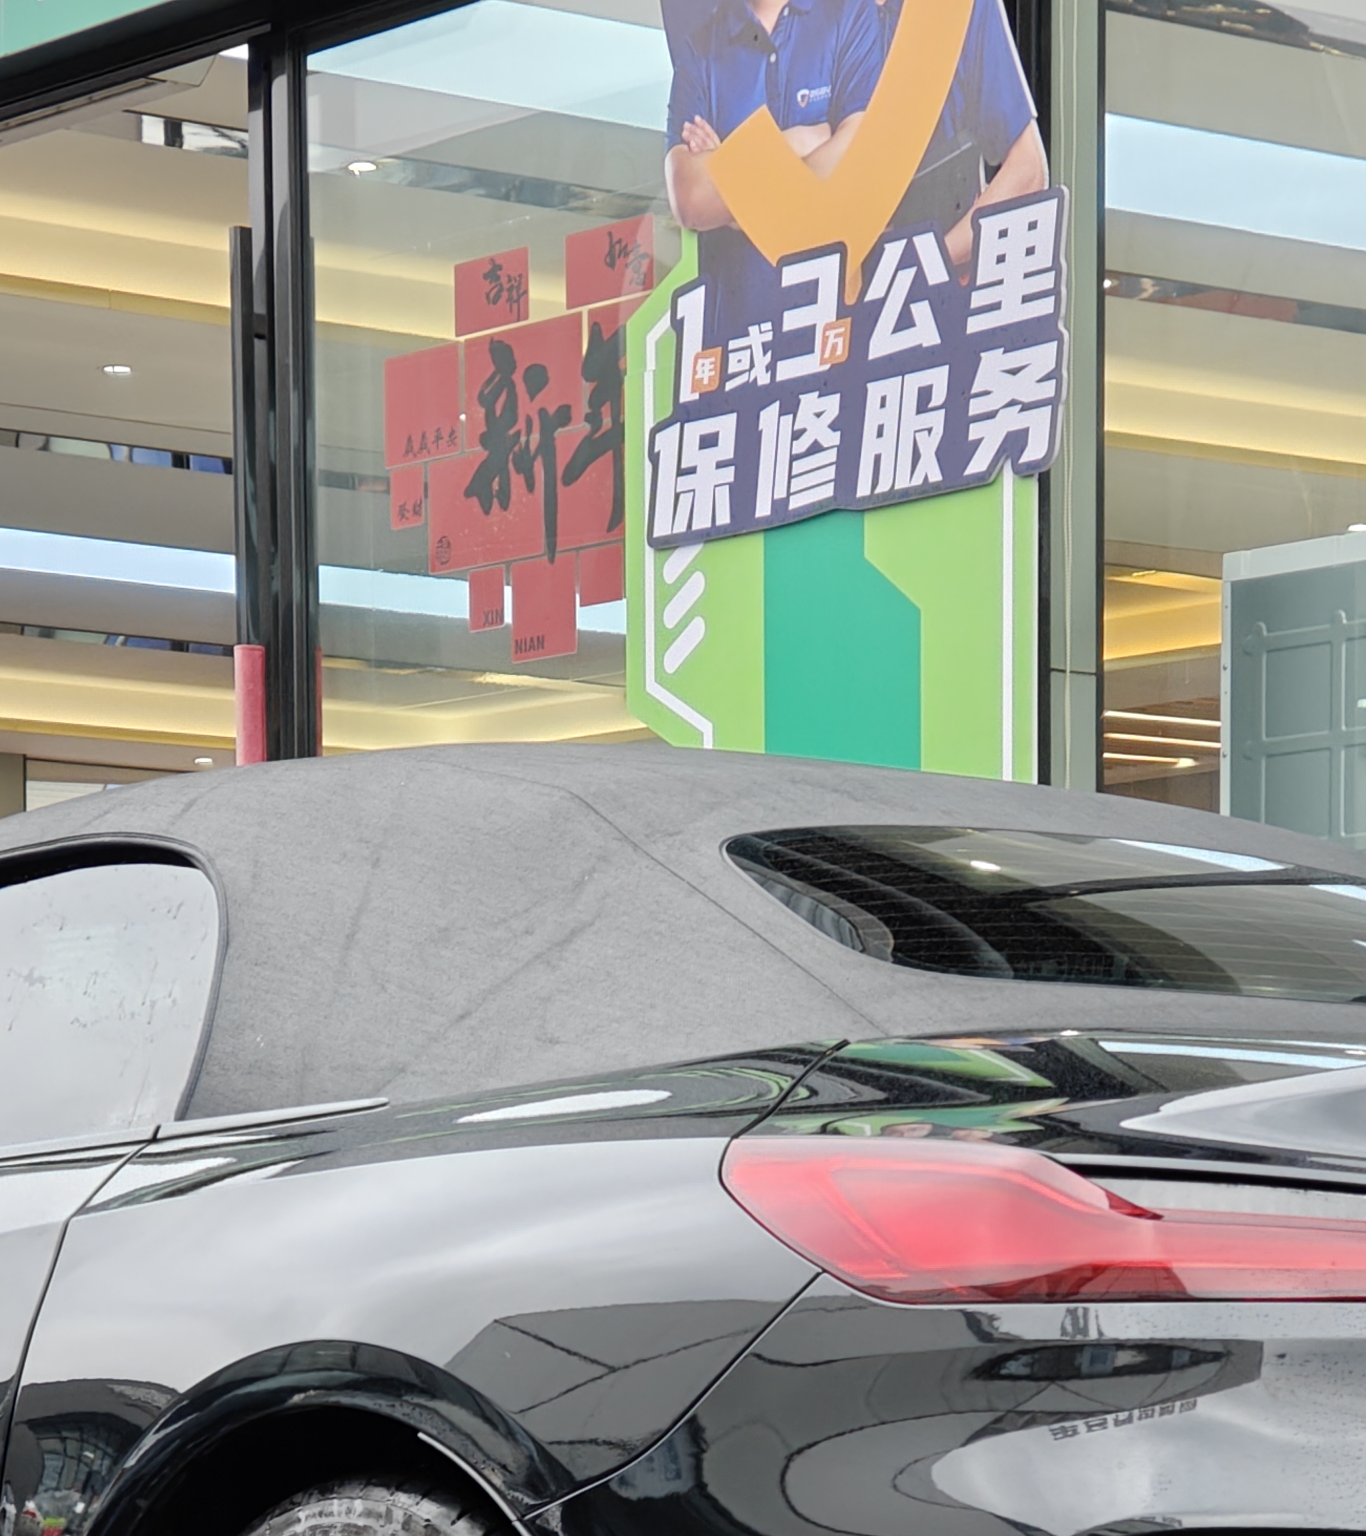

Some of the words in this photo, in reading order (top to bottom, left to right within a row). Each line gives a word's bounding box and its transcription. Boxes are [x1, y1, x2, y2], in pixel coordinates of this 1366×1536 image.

[651, 341, 1060, 540] 保修服务
[514, 635, 546, 655] NIAN
